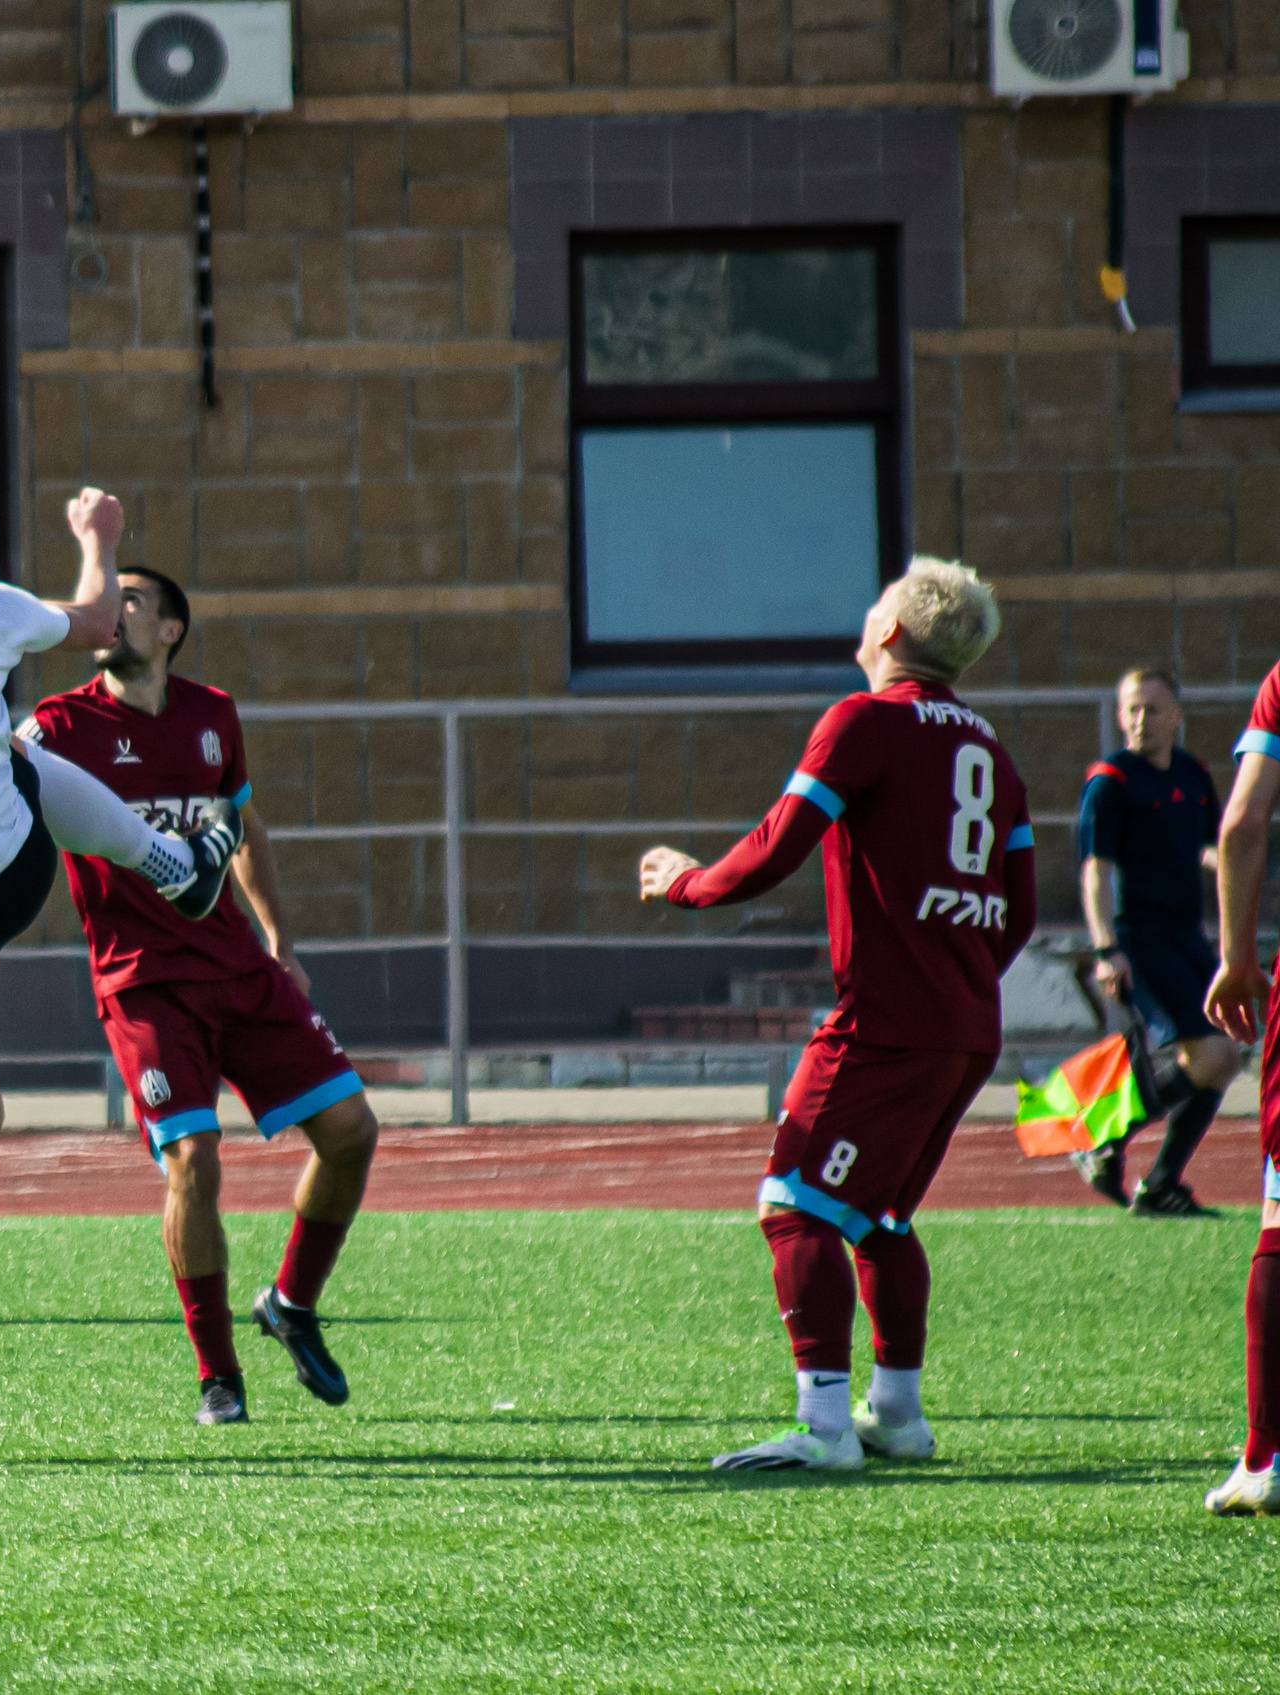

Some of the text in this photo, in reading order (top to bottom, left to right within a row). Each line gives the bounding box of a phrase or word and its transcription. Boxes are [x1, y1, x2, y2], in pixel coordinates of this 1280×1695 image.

[951, 744, 995, 876] 8
[917, 886, 1008, 932] PAR
[821, 1139, 859, 1188] 8
